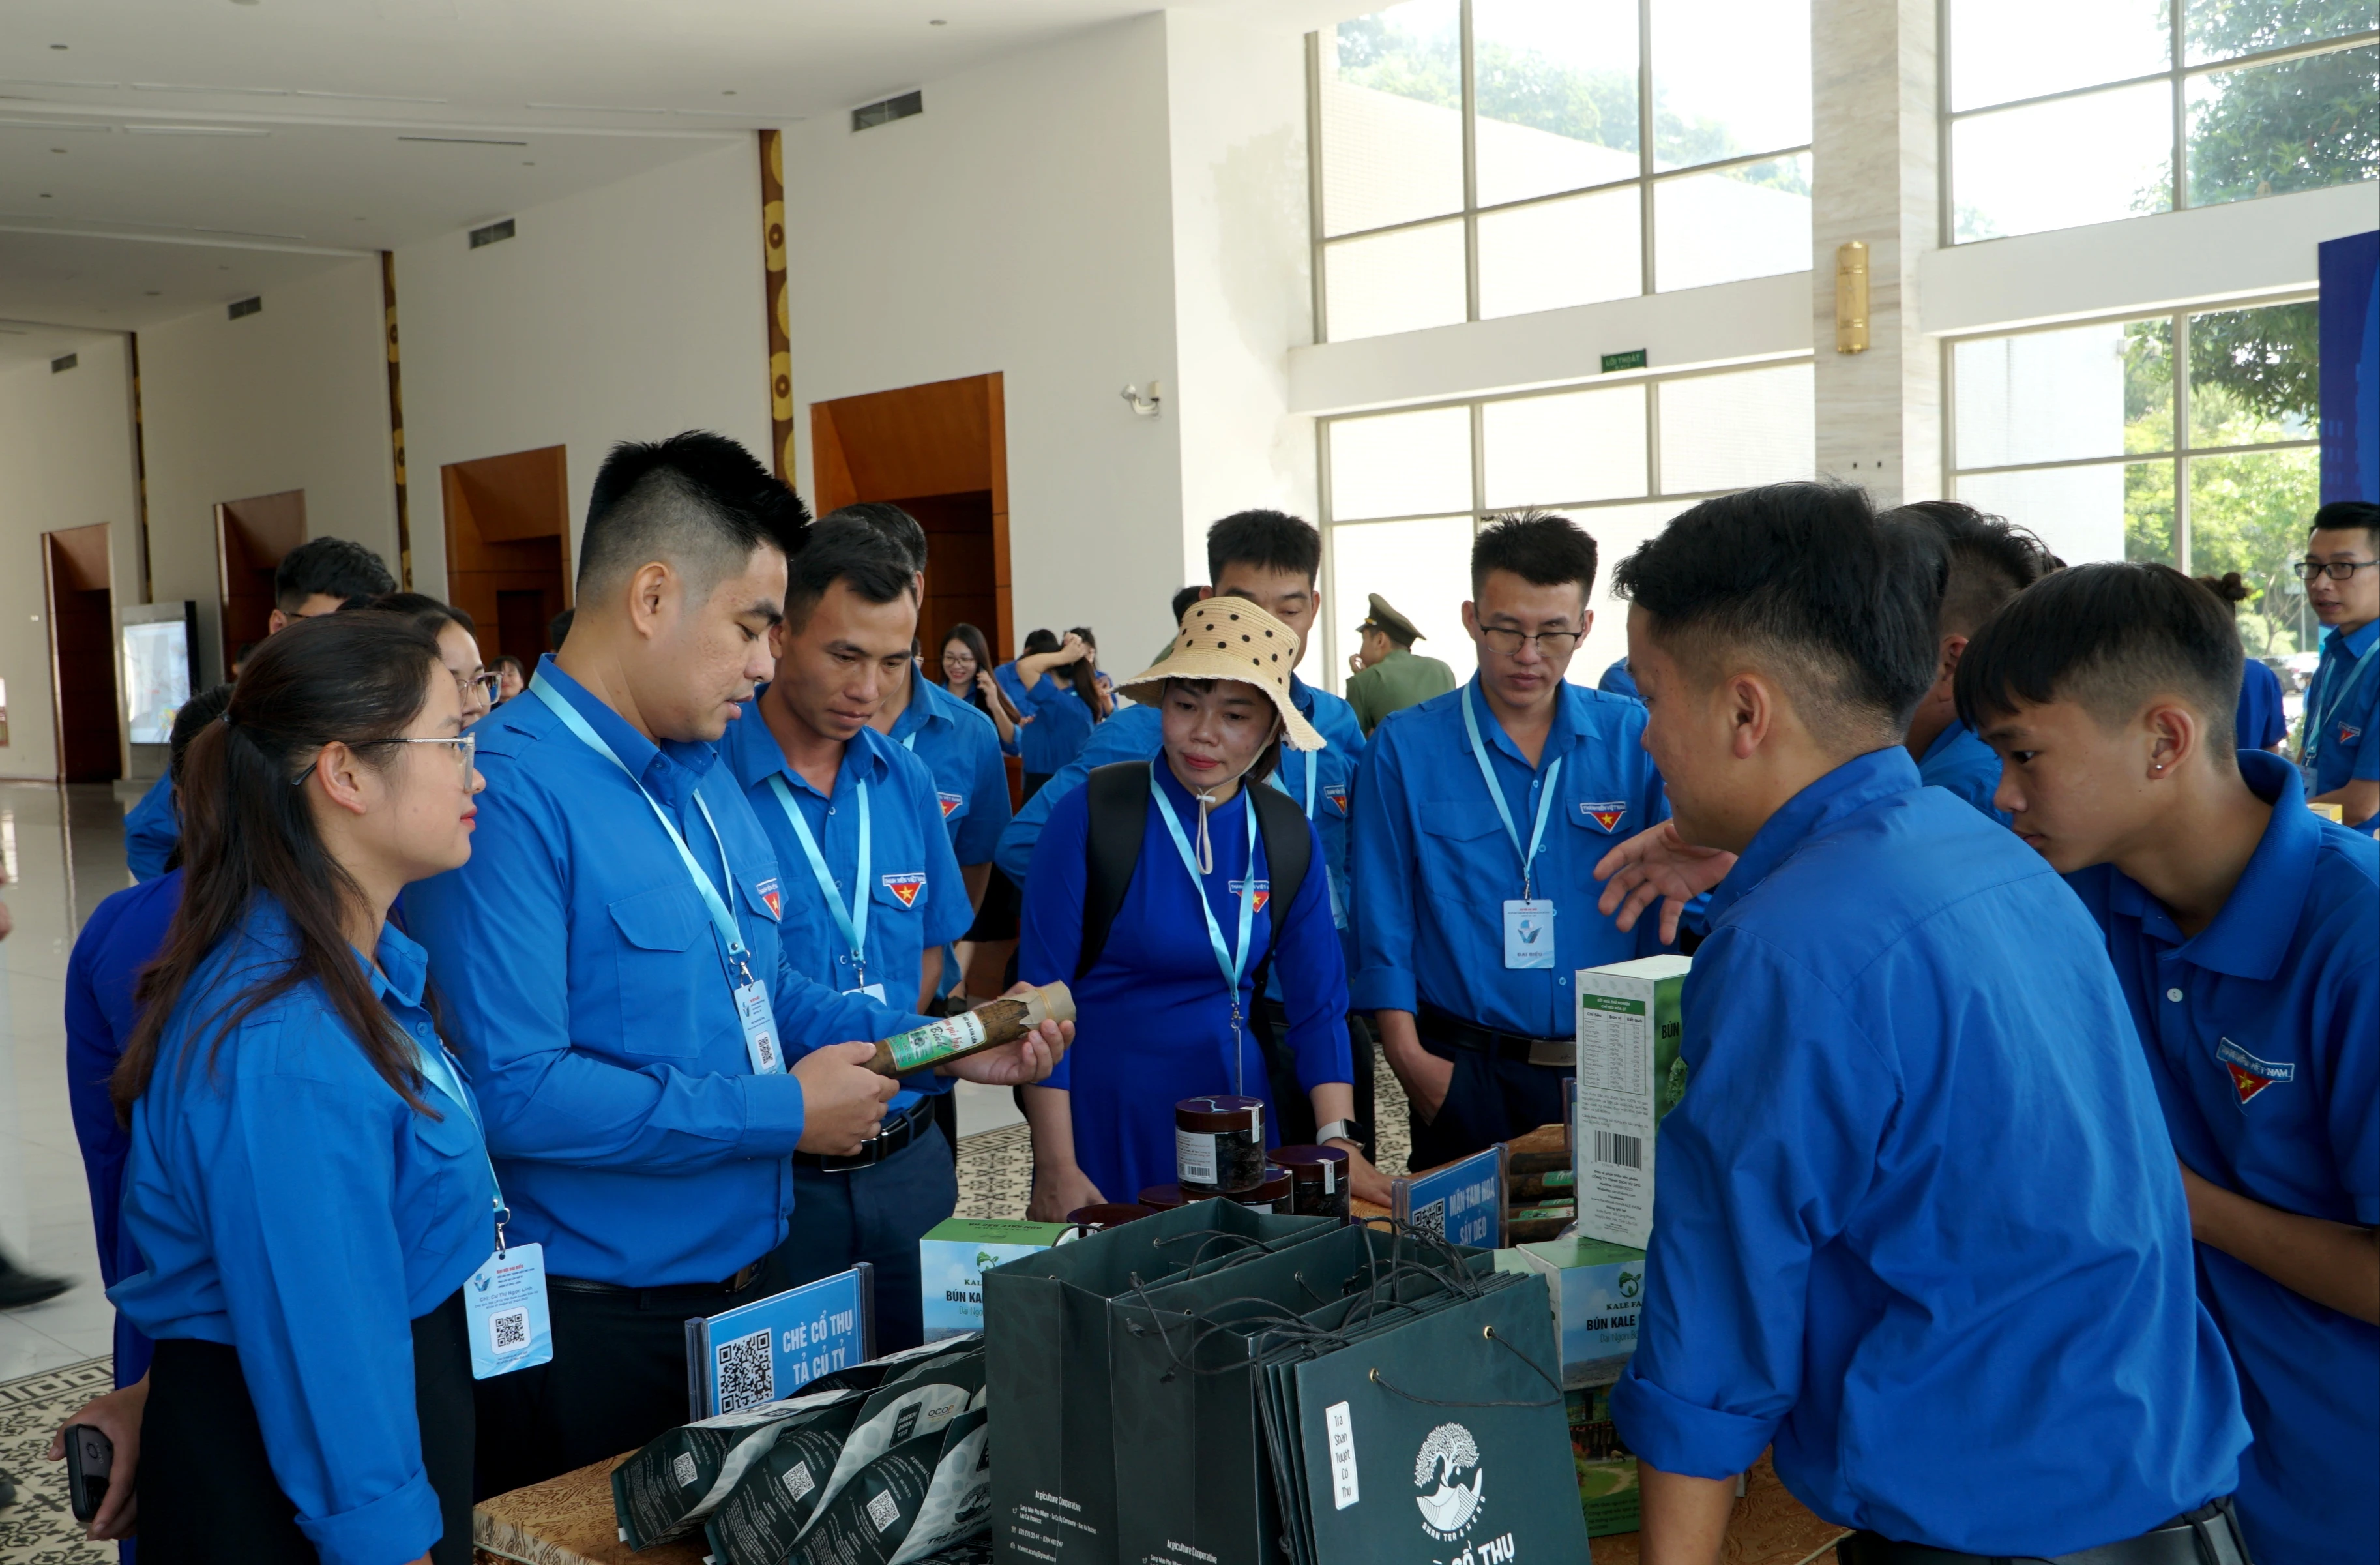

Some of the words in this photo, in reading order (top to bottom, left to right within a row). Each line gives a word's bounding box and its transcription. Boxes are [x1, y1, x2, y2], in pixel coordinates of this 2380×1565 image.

[930, 1026, 948, 1047] Bình
[1662, 1021, 1679, 1039] BÚN
[952, 1037, 964, 1049] bếp
[2267, 1067, 2288, 1077] NAM
[1450, 1188, 1465, 1219] MẬN
[1465, 1183, 1480, 1209] TAM
[1482, 1177, 1495, 1202] HOA
[1460, 1216, 1472, 1245] SẤY
[1473, 1209, 1486, 1242] DẺO
[946, 1289, 966, 1302] BÚN
[969, 1292, 982, 1304] KA
[971, 1306, 983, 1317] Ngo
[782, 1321, 808, 1353] CHÈ
[811, 1310, 827, 1343] CỔ
[829, 1309, 853, 1336] THỤ
[1587, 1317, 1608, 1331] BÚN
[1611, 1315, 1635, 1328] KALE
[793, 1352, 810, 1385] TẢ
[813, 1345, 829, 1379] CỦ
[831, 1338, 845, 1371] TỶ
[899, 1412, 917, 1423] GREEN
[928, 1405, 954, 1416] OCOP
[1334, 1414, 1344, 1427] Trà
[1334, 1433, 1348, 1446] Shan
[1035, 1489, 1058, 1504] Argiculture
[1059, 1496, 1081, 1512] Cooperative
[1422, 1522, 1441, 1540] SHAN
[1443, 1533, 1458, 1542] TEA
[1459, 1528, 1464, 1538] &
[1465, 1495, 1486, 1532] HERB
[1167, 1539, 1192, 1555] Argiculture
[1192, 1547, 1218, 1564] Cooperative
[1478, 1532, 1515, 1565] THỤ
